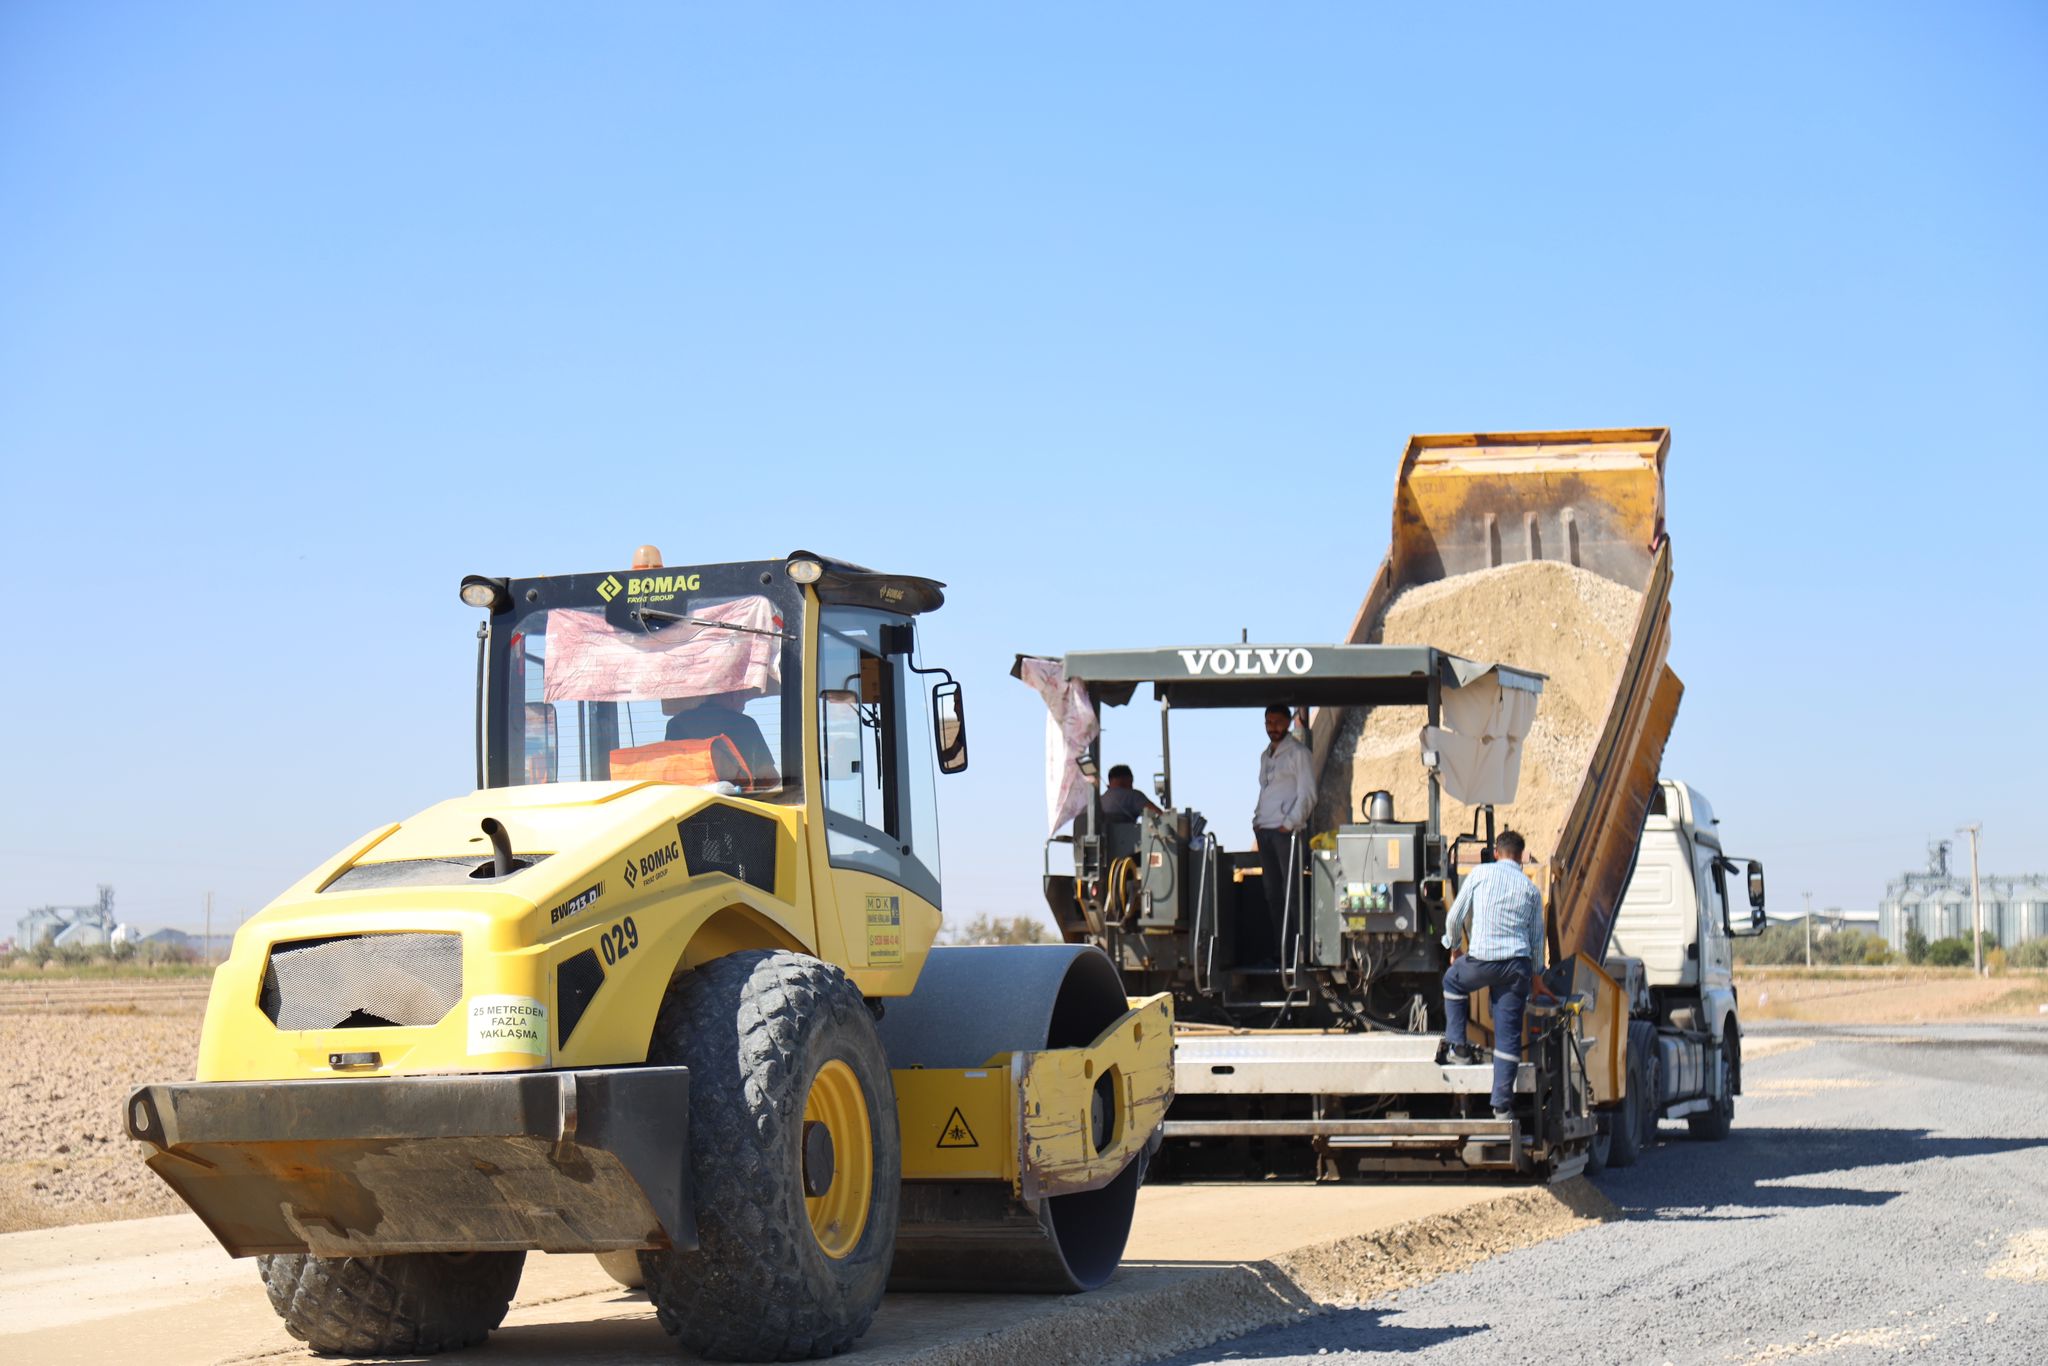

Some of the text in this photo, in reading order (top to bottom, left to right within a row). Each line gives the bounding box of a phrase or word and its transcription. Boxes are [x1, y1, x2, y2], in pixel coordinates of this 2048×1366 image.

[627, 574, 700, 595] BOMAG
[627, 594, 675, 604] FAYAT GROUP
[1177, 648, 1313, 675] VOLVO
[640, 841, 679, 877] BOMAG
[600, 916, 639, 966] 029
[473, 1005, 544, 1018] 25 METREDEN
[491, 1017, 527, 1026] FAZLA
[480, 1029, 538, 1040] YAKLAŞMA
